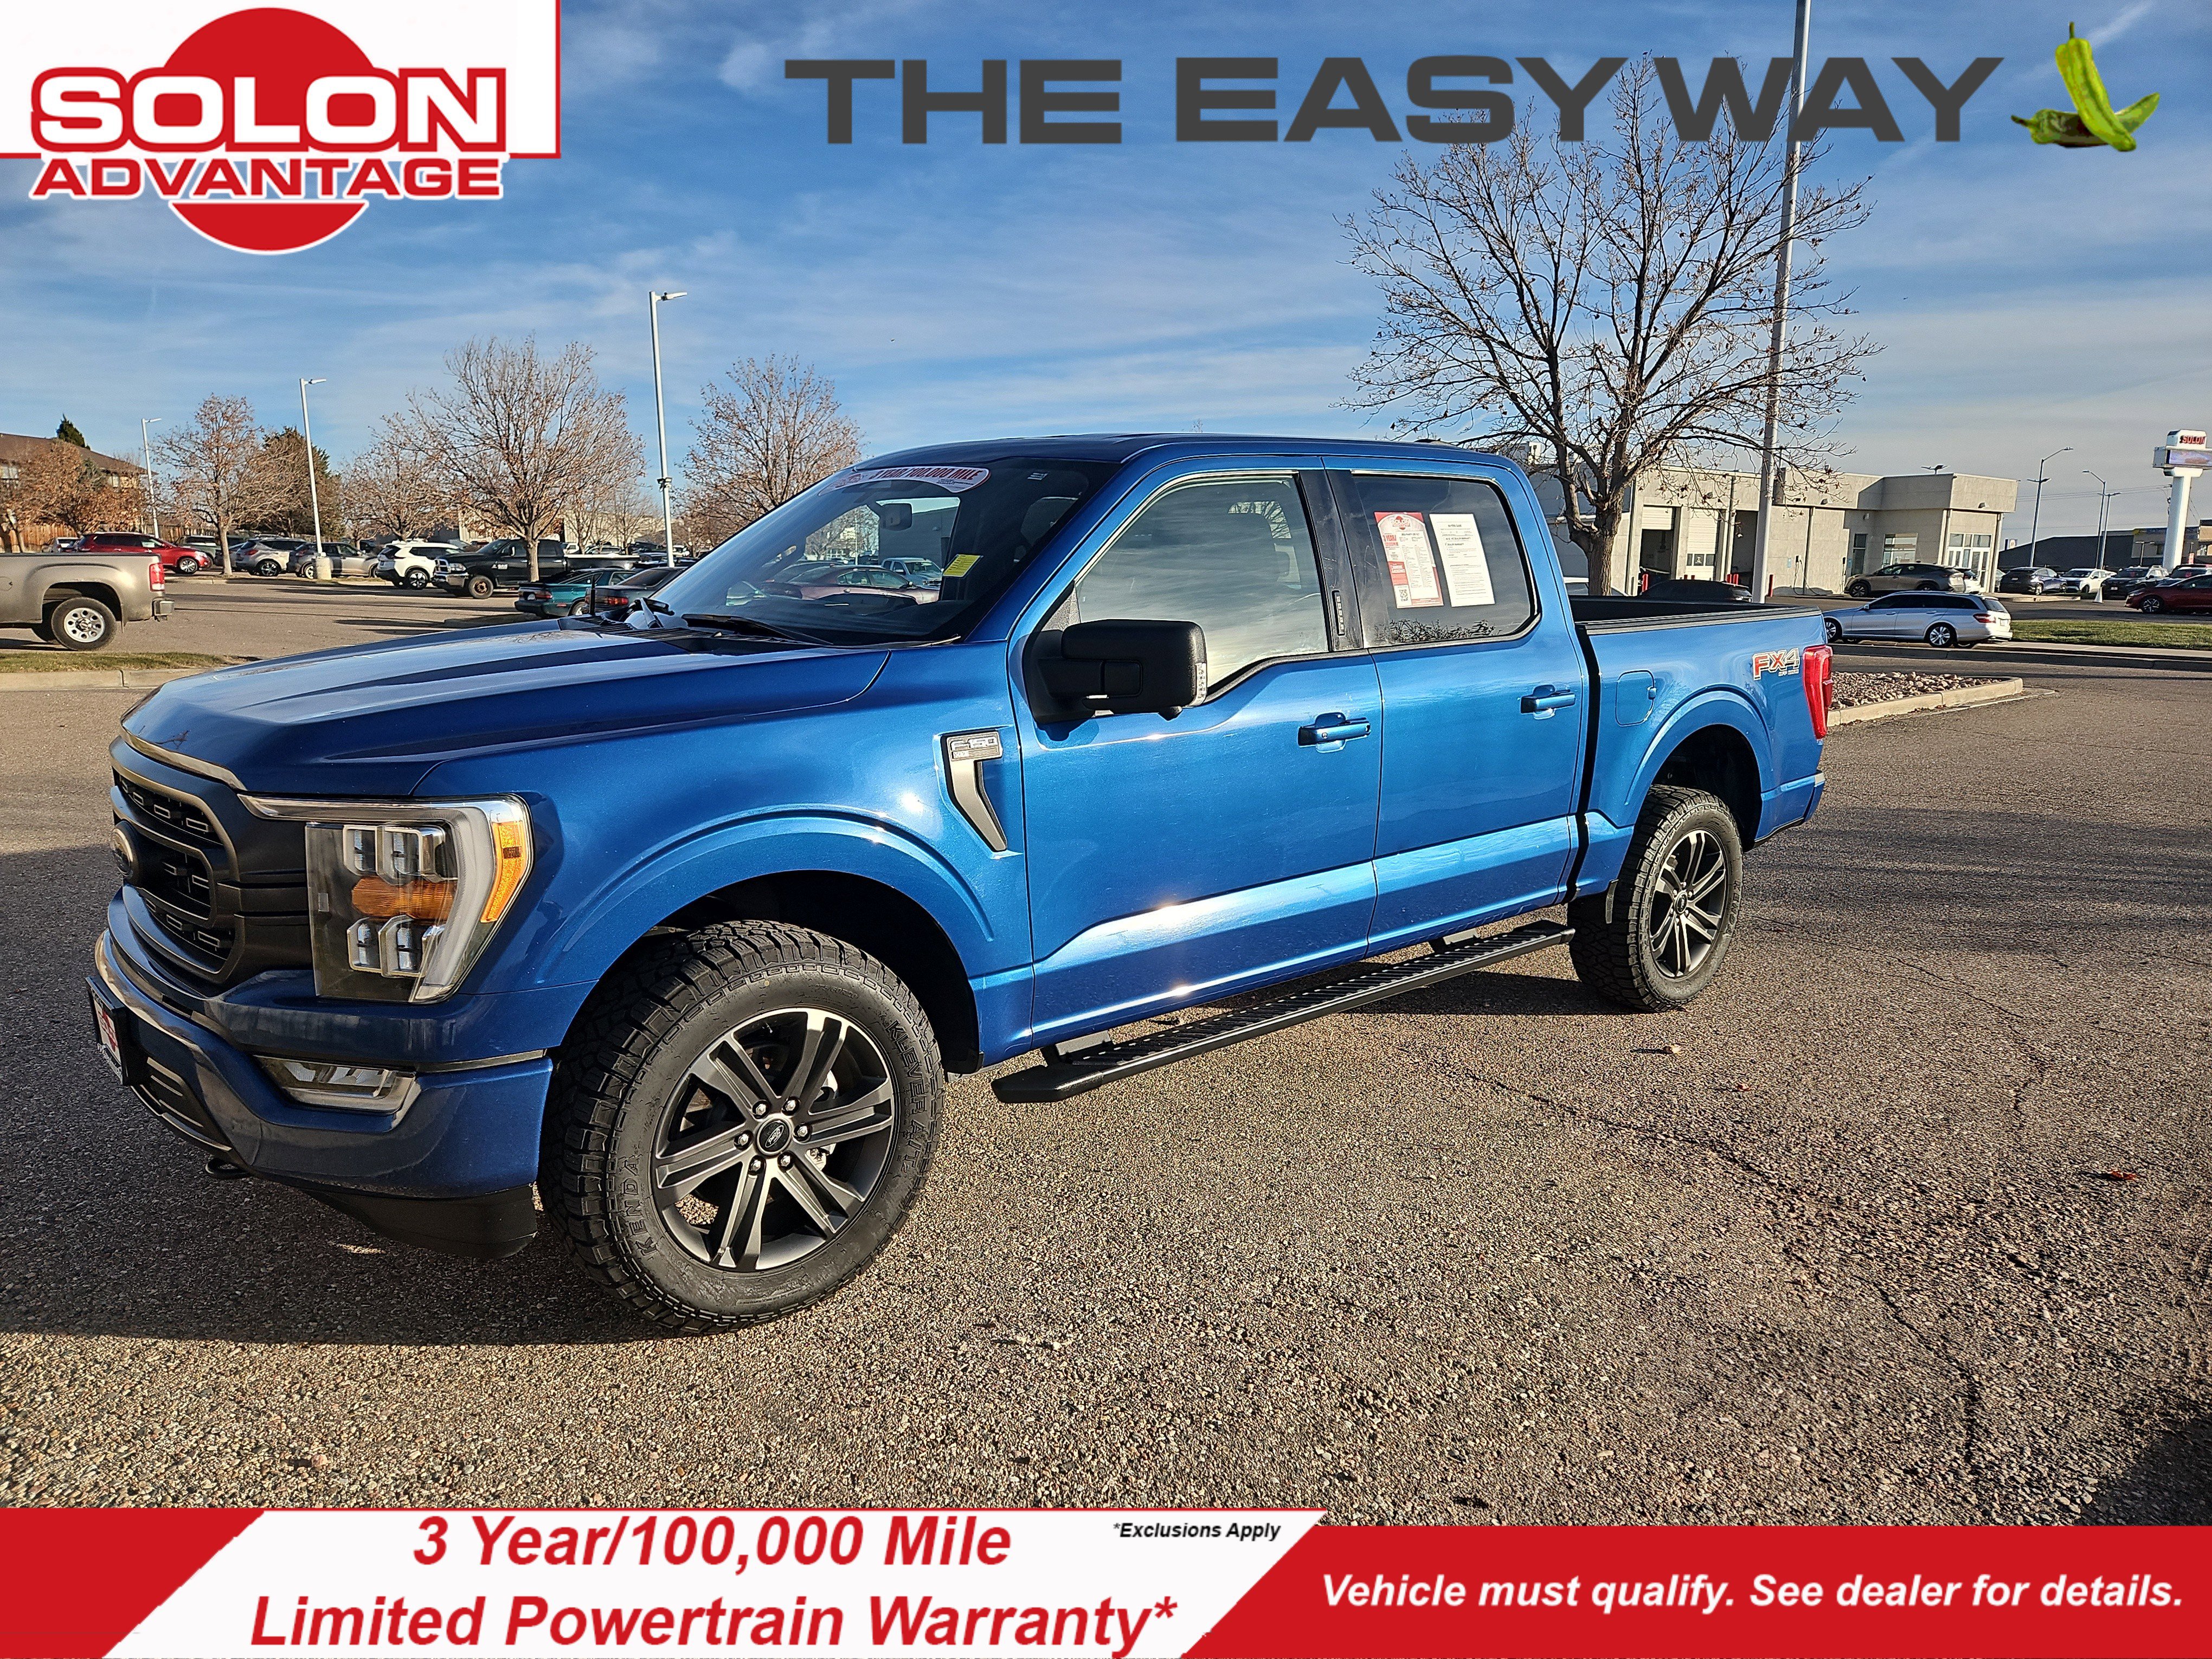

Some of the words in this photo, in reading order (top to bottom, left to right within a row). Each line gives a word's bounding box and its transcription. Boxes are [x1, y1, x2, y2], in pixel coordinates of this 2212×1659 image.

[2182, 435, 2205, 445] SOLON
[947, 468, 983, 480] MILE
[1752, 648, 1800, 680] FX4
[885, 1019, 927, 1115] KLEVER
[623, 1156, 659, 1256] KENDA
